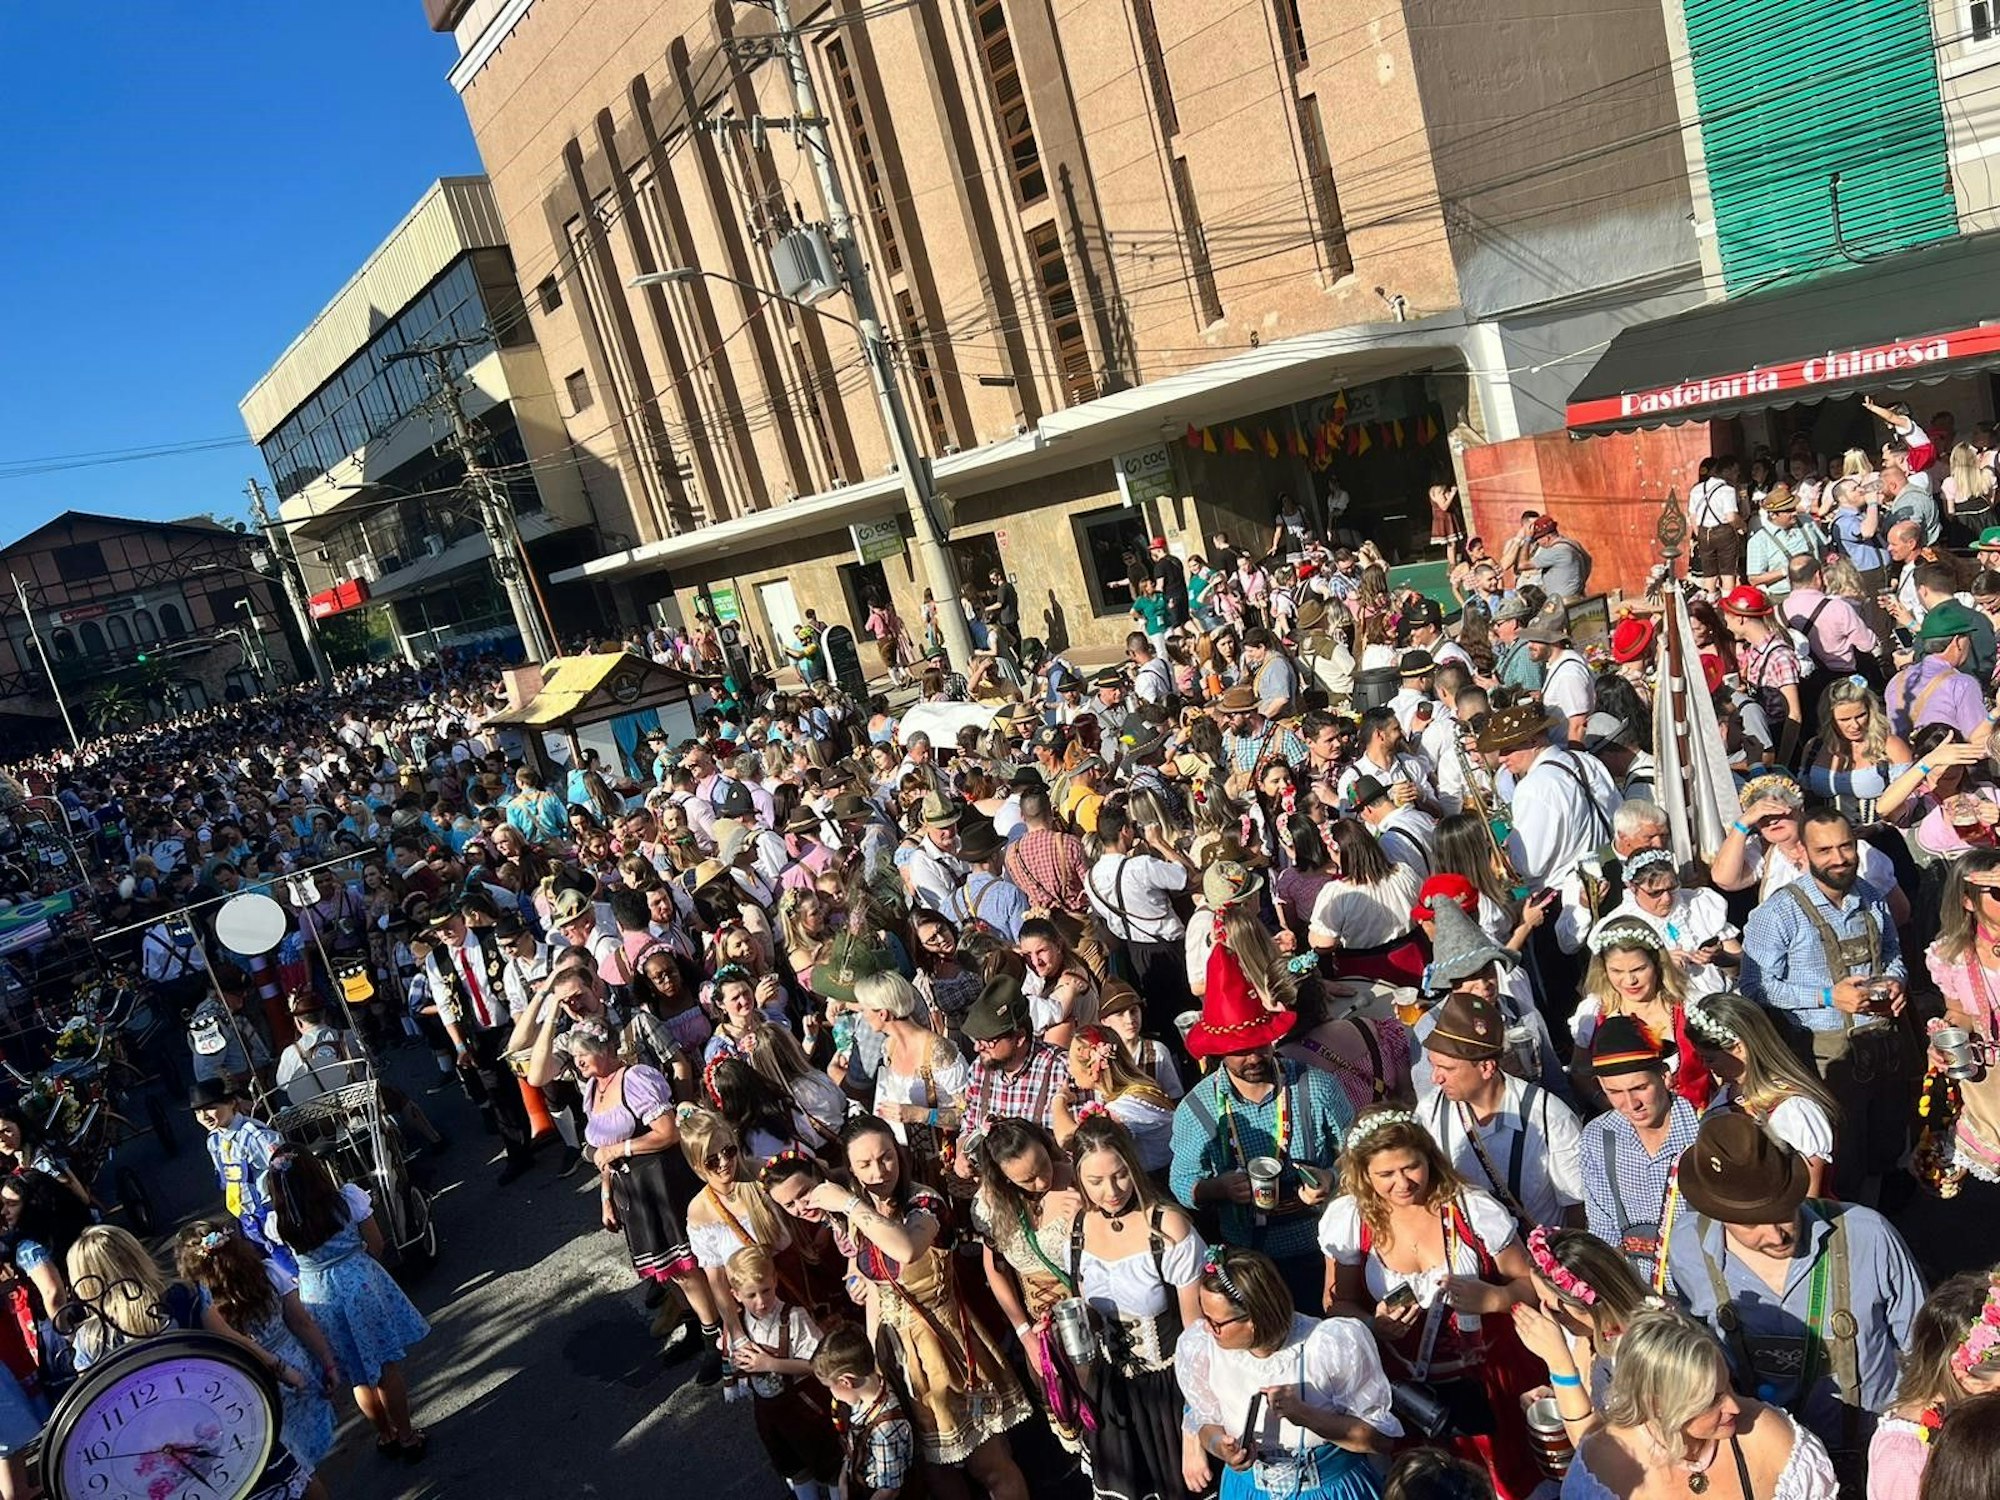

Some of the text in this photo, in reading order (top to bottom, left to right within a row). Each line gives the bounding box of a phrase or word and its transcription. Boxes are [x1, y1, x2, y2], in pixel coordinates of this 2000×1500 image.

[1621, 338, 1949, 416] Pastelaria Chinesa
[129, 1382, 159, 1409] 12
[174, 1376, 185, 1394] 1
[204, 1381, 225, 1403] 2
[101, 1407, 124, 1431] 11
[225, 1403, 243, 1425] 3
[83, 1440, 111, 1466] 10
[227, 1433, 246, 1452] 4
[88, 1473, 109, 1495] 9
[212, 1463, 230, 1488] 5
